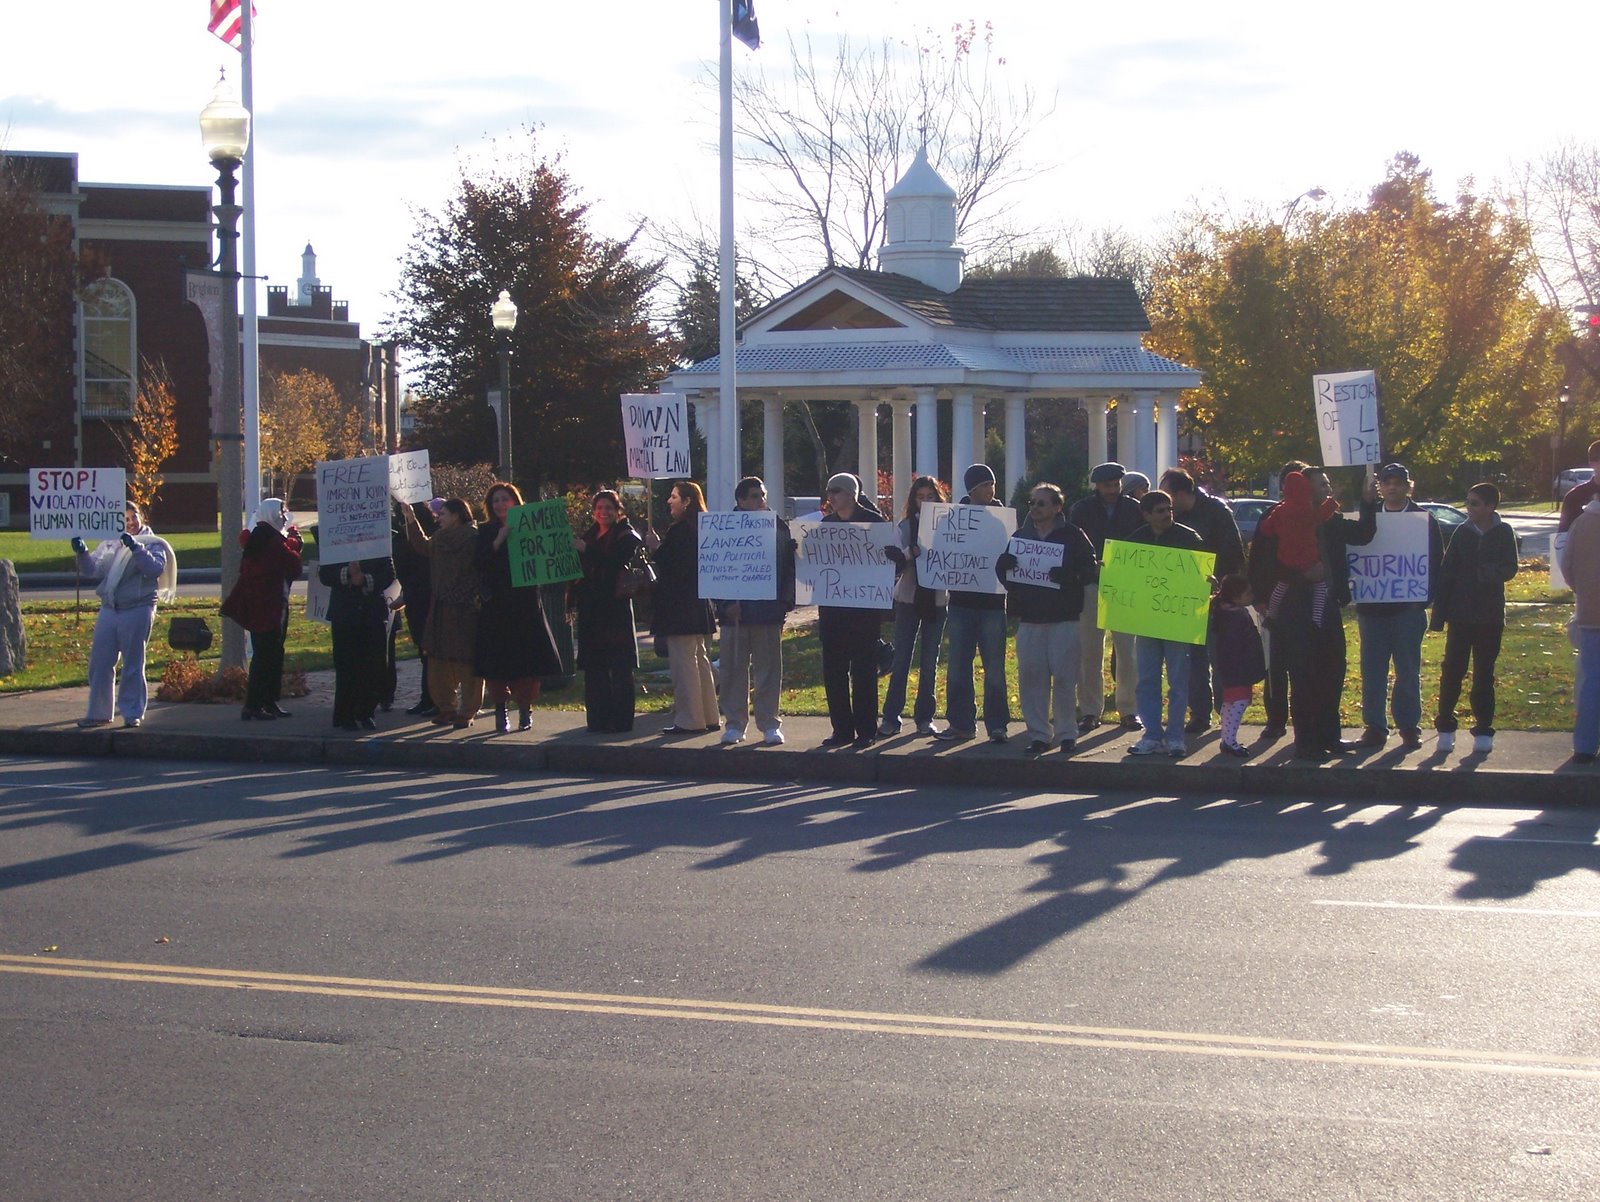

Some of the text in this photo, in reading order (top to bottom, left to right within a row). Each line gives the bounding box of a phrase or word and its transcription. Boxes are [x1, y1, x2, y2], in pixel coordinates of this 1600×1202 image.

[1317, 379, 1375, 405] RESTOR
[629, 403, 679, 433] DOWN
[1322, 410, 1340, 431] OF
[642, 434, 670, 448] WITH
[666, 450, 690, 474] LAW
[37, 470, 97, 492] STOP!
[322, 463, 372, 485] FREE
[31, 494, 121, 510] VIOLATION OF
[326, 486, 361, 501] IMRAN
[326, 500, 385, 514] SPEAKING OUT
[33, 511, 126, 533] HUMAN RIGHTS
[932, 505, 984, 532] FREE
[700, 535, 763, 550] LAWYERS
[800, 524, 871, 541] SUPPORT
[942, 533, 966, 544] THE
[519, 534, 546, 558] FOR
[699, 550, 767, 562] AND POLITICAL
[805, 543, 863, 566] HUMAN
[1015, 540, 1064, 558] DEMOCRACY
[521, 558, 537, 582] IN
[741, 563, 772, 573] JAILED
[926, 548, 990, 573] PAKISTANI
[1029, 557, 1040, 568] IN
[1112, 547, 1214, 576] AMERICANS
[1347, 552, 1428, 578] RTURING
[931, 571, 980, 587] MEDIA
[1012, 565, 1051, 582] PAKIST
[1144, 575, 1170, 592] FOR
[805, 568, 894, 602] IN PAKISTAN
[1348, 579, 1429, 600] AWYERS
[1101, 584, 1137, 609] FREE
